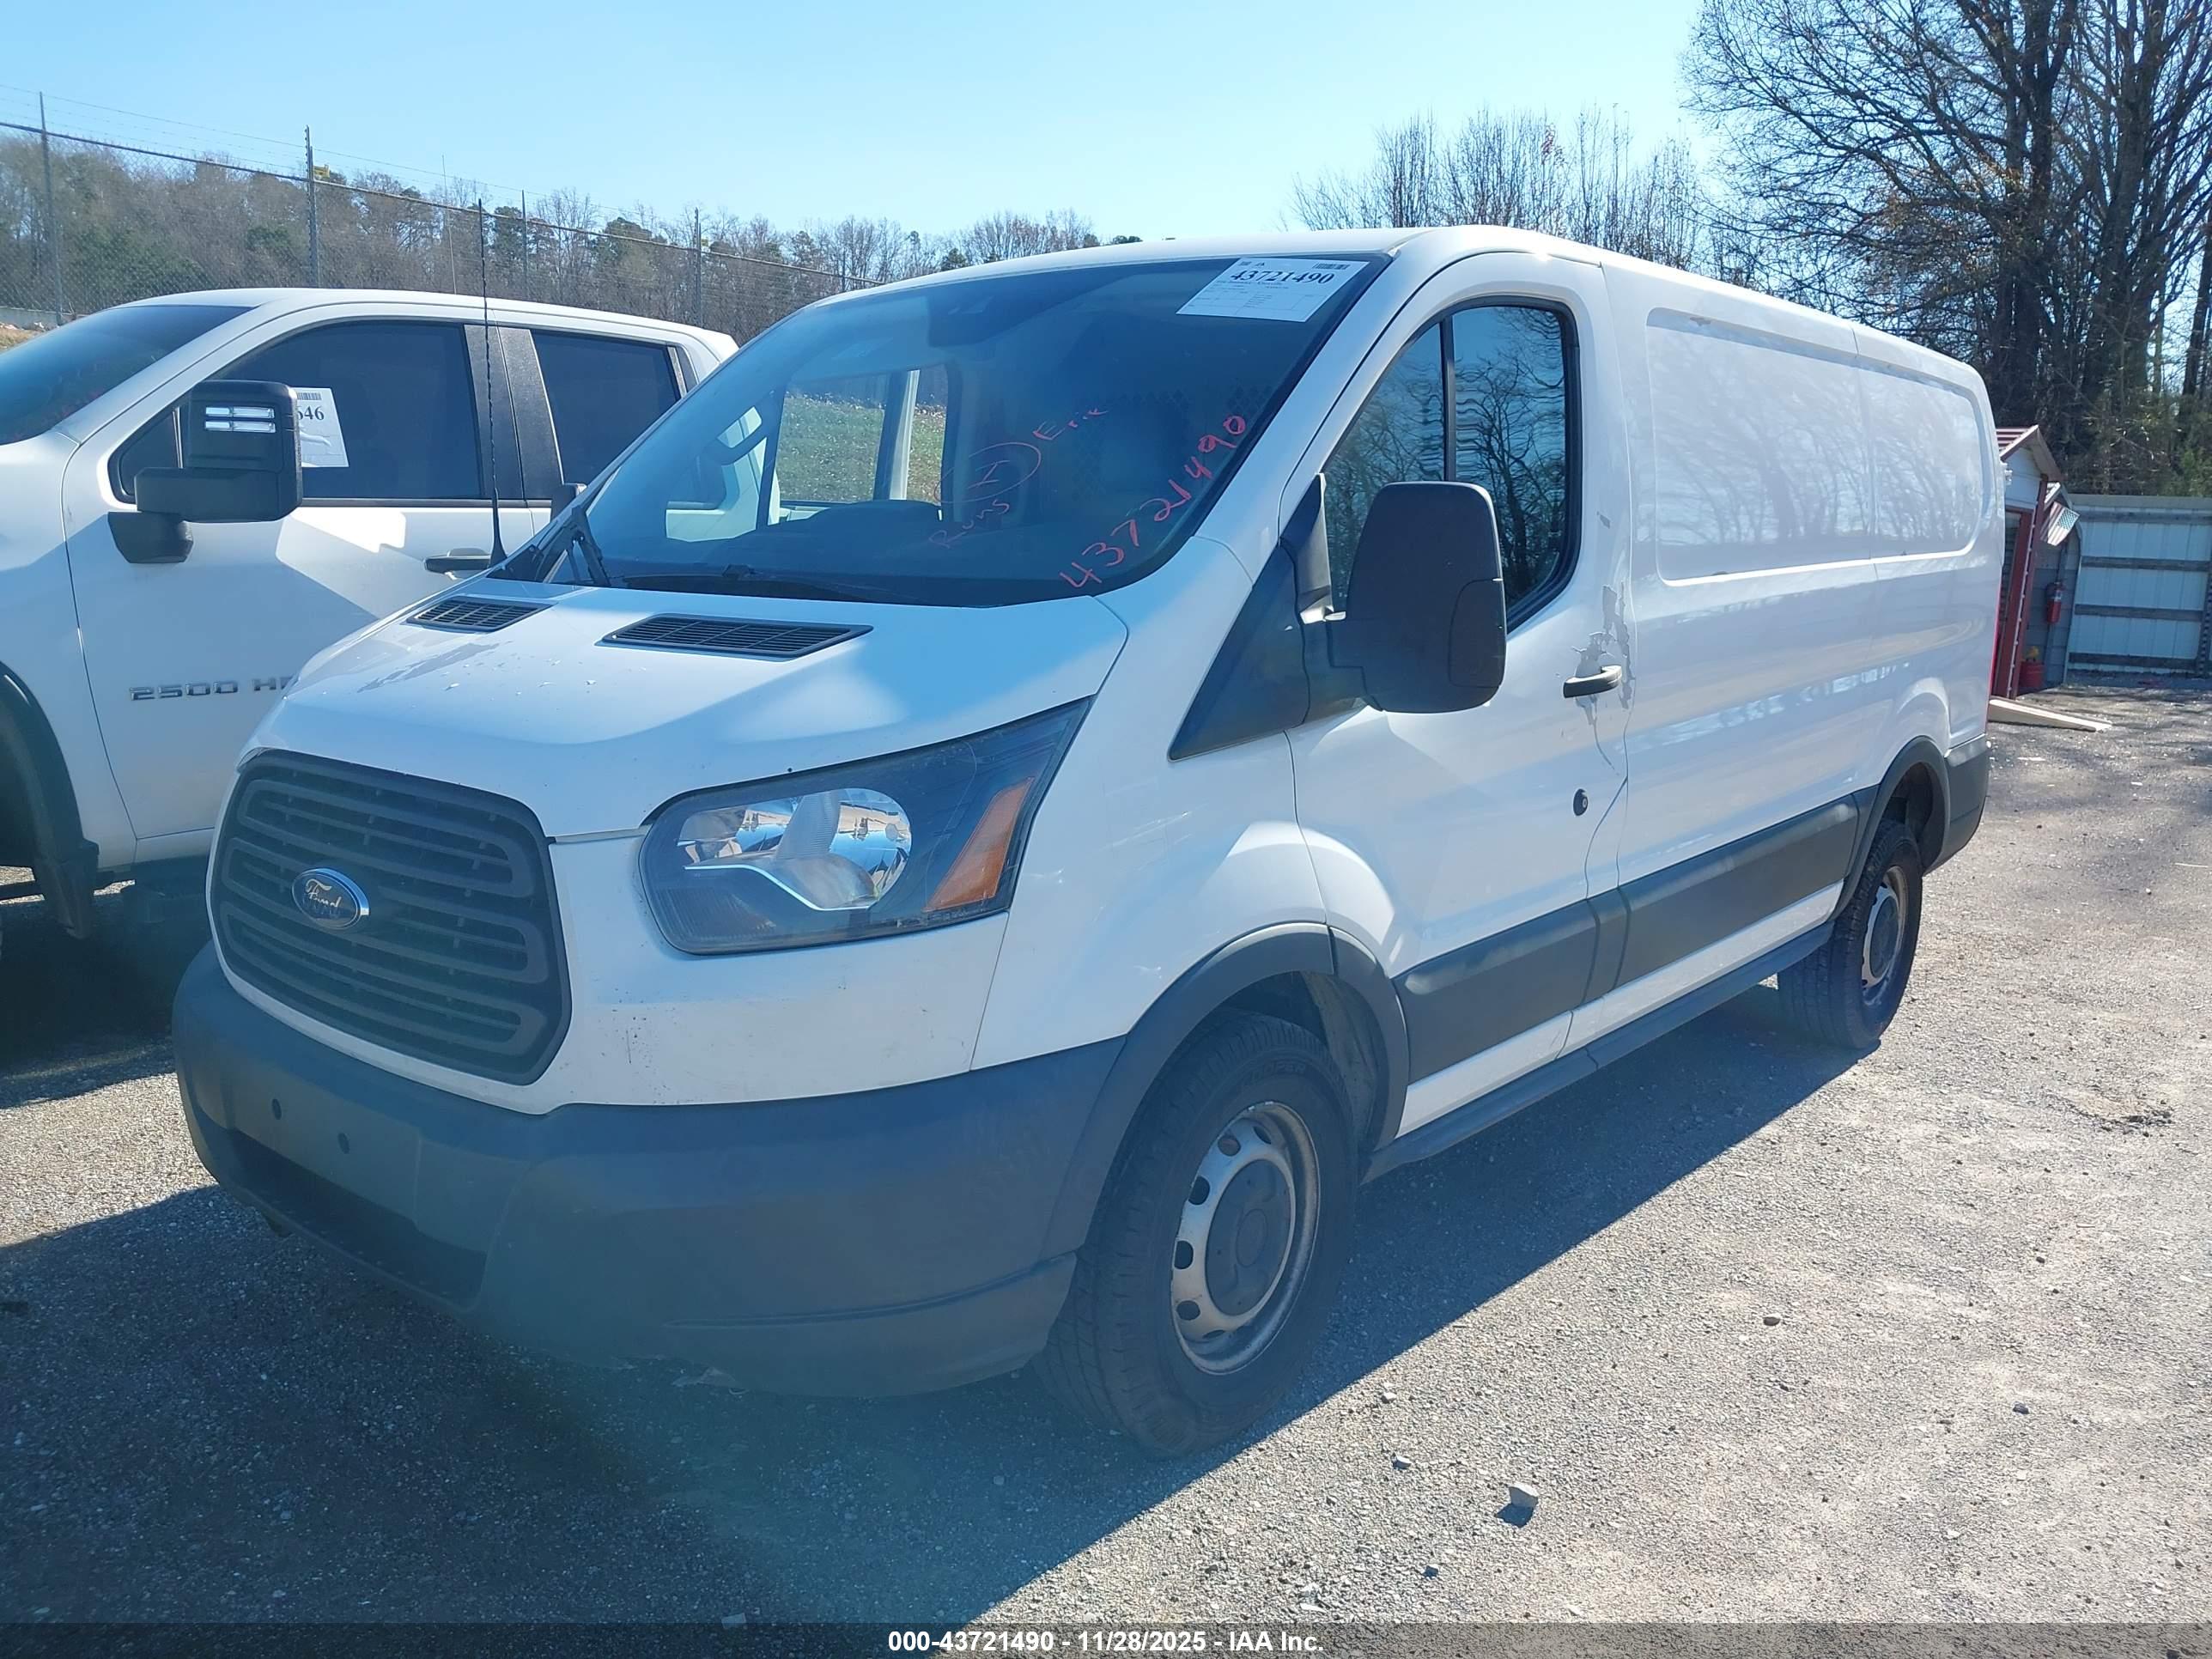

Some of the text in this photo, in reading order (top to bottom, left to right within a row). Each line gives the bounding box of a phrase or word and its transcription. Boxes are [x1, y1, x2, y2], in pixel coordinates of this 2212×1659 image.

[1231, 270, 1334, 284] 43721490
[1060, 415, 1247, 588] 43721490
[130, 681, 238, 701] 2500
[305, 878, 342, 908] Ford
